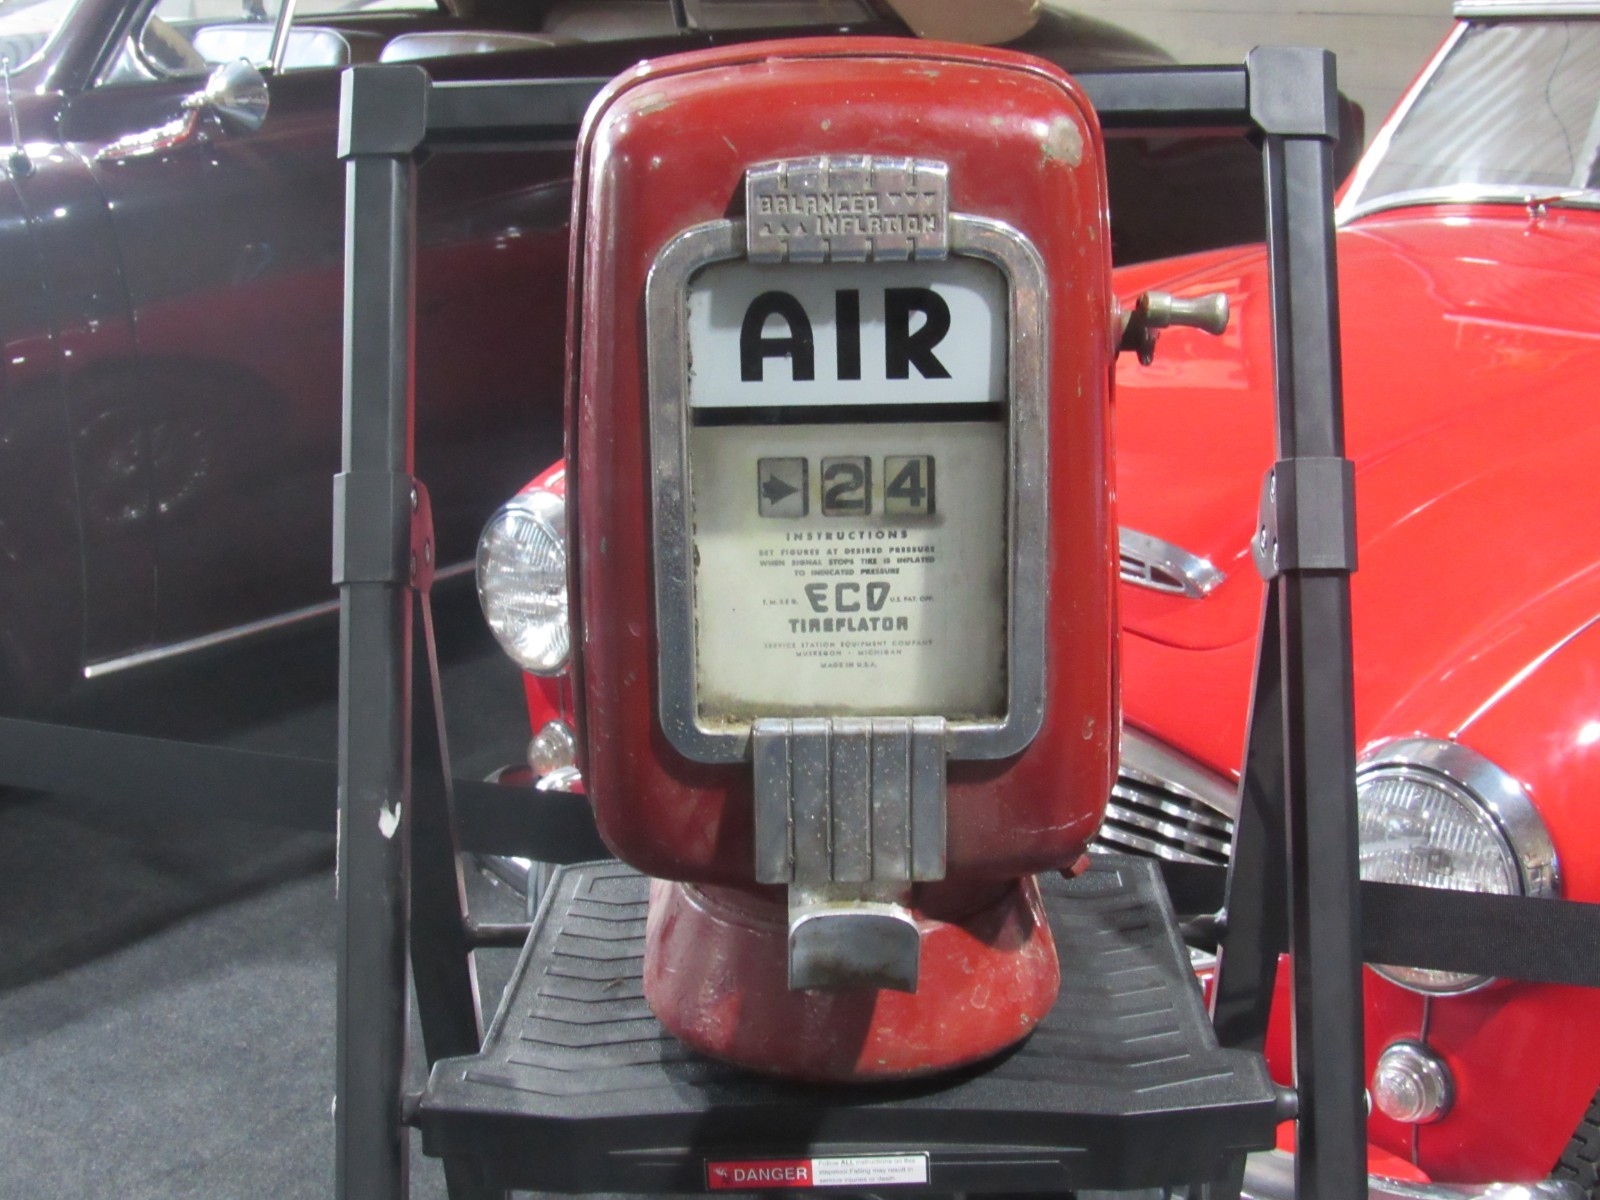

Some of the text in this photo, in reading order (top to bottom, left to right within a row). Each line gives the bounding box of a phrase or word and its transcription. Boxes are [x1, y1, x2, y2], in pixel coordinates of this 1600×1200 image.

[758, 193, 880, 215] BALANCED
[815, 214, 936, 236] INFLATION
[740, 287, 953, 382] AIR
[786, 530, 908, 542] INSTRUCTIONS
[780, 548, 820, 556] FIGURES
[844, 547, 883, 555] DESIRED
[888, 545, 936, 554] PRESSURE
[828, 558, 854, 566] STOPS
[860, 557, 877, 565] TIRE
[896, 556, 936, 564] INFLATED
[810, 569, 855, 577] INDICATED
[860, 567, 900, 575] PRESSURE
[804, 581, 891, 614] ECO
[788, 616, 909, 634] TIREFLATOR
[840, 640, 887, 648] EQUIPMENT
[733, 1167, 808, 1183] DANGER
